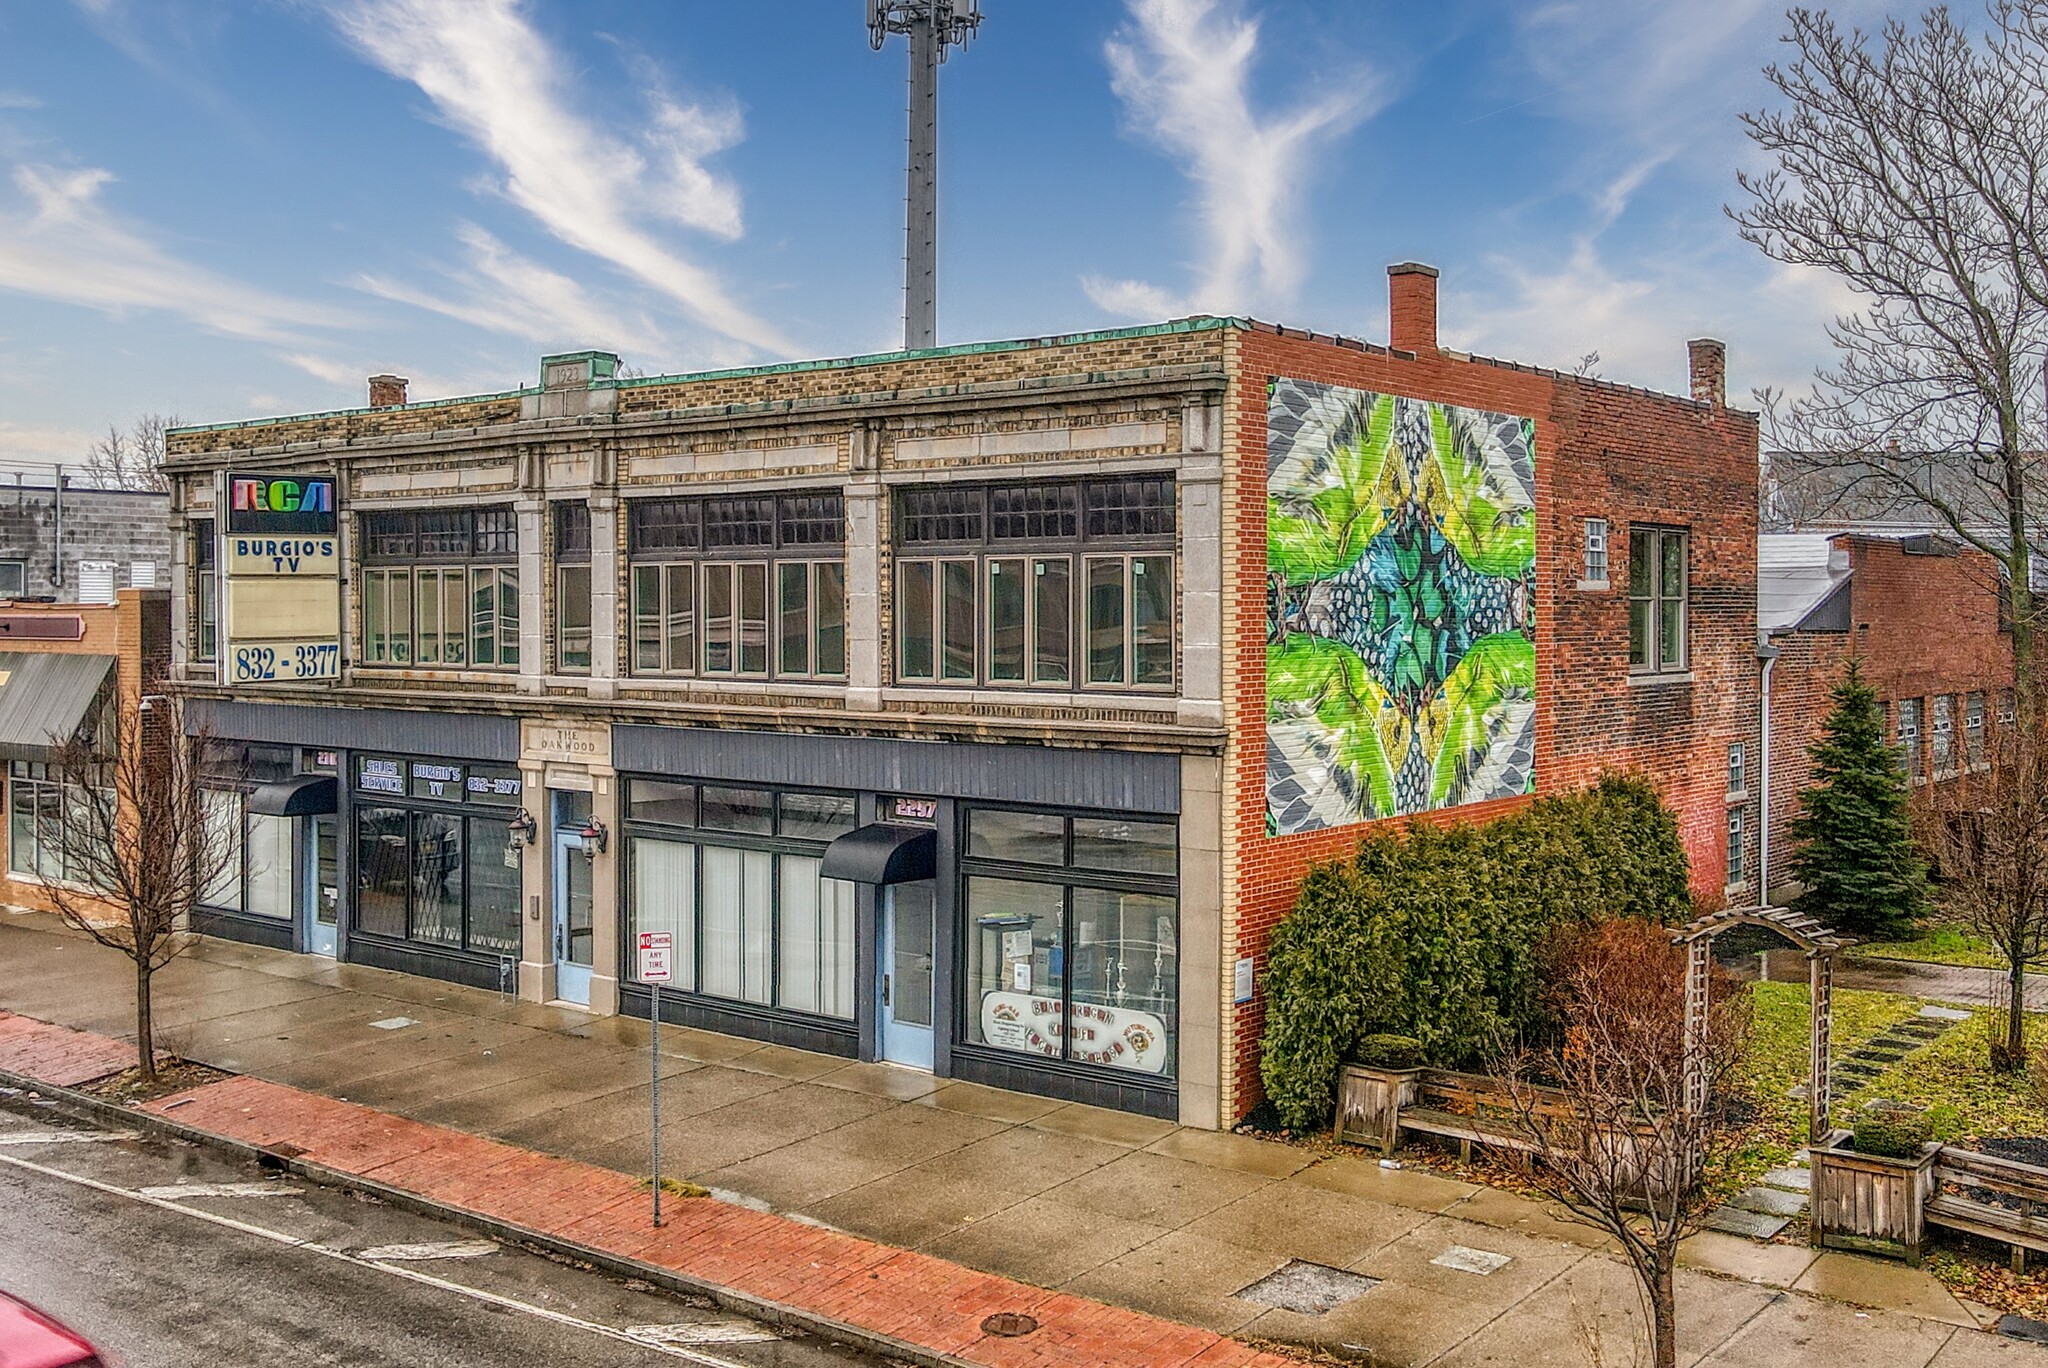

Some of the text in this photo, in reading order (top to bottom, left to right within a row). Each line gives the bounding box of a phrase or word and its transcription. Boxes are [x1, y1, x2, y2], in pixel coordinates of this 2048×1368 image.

[556, 367, 579, 384] 1923
[233, 479, 333, 513] RCA
[237, 540, 333, 557] BURGIO'S
[273, 557, 300, 573] TV
[236, 647, 276, 680] 832
[295, 644, 339, 678] 3377
[557, 730, 579, 741] THE
[541, 739, 596, 752] OAKWOOD
[366, 759, 398, 776] SALES
[412, 763, 461, 782] BURGIO'S
[360, 775, 403, 793] SERVICE
[428, 781, 445, 797] TV
[467, 777, 522, 795] 832-3377
[895, 798, 937, 818] 2297
[640, 936, 651, 946] NO
